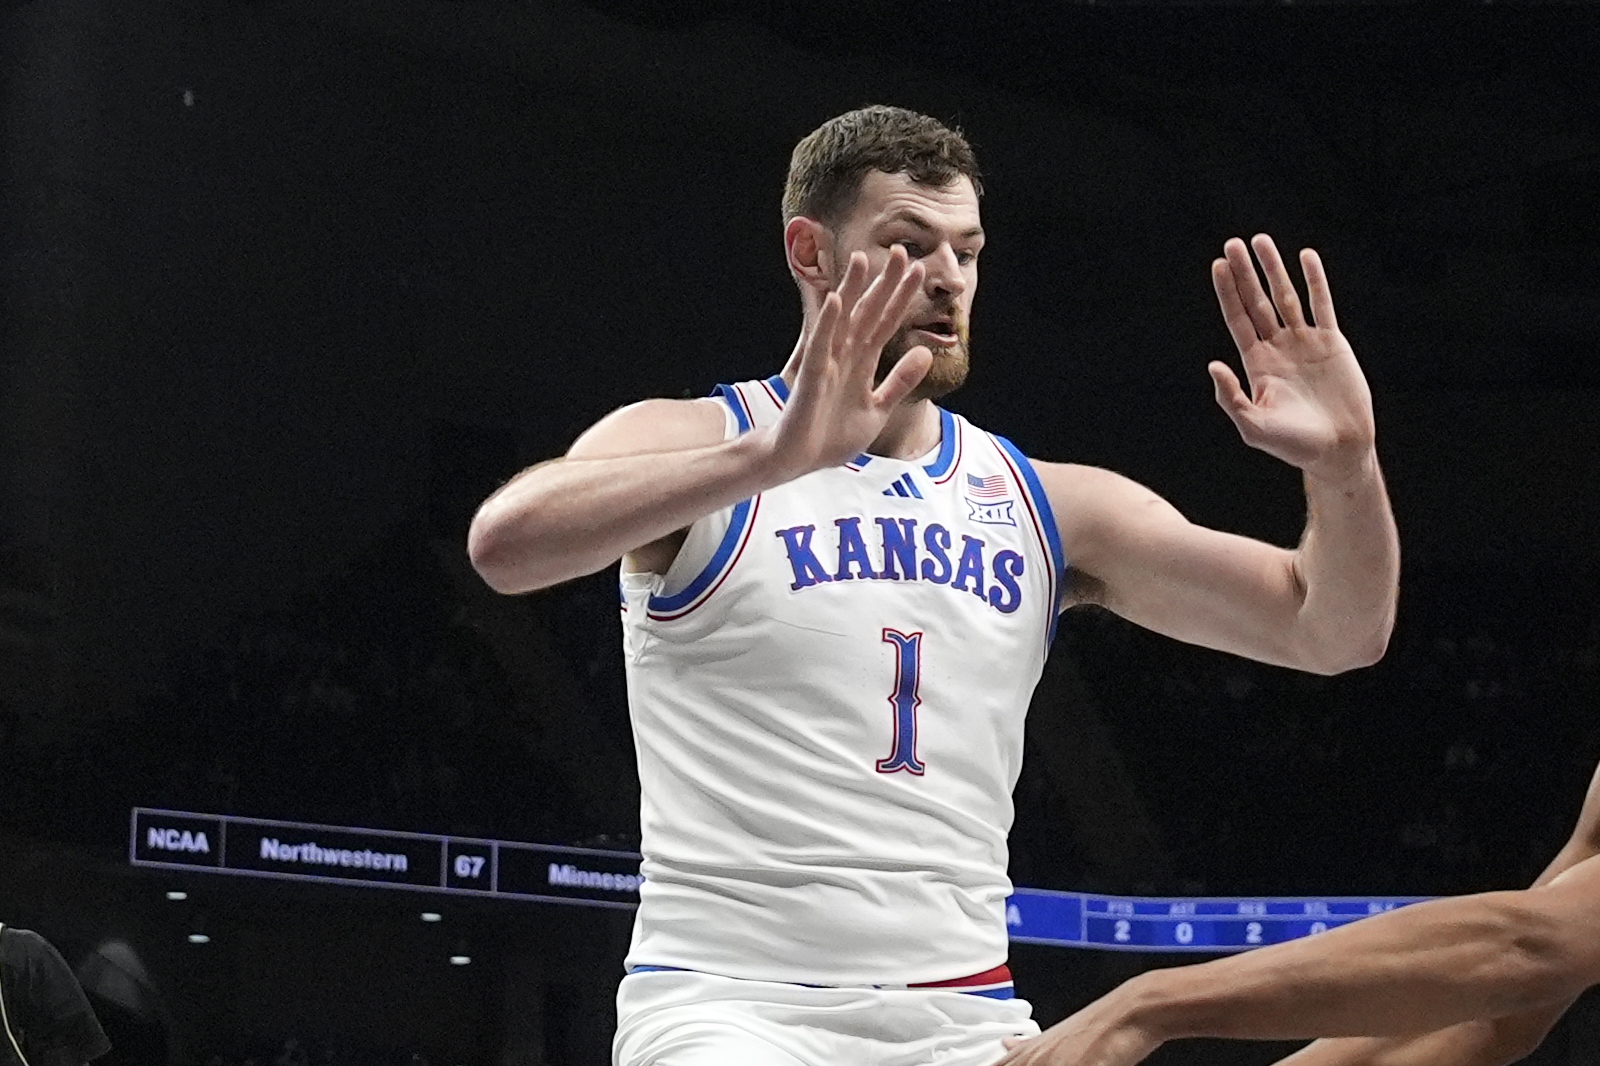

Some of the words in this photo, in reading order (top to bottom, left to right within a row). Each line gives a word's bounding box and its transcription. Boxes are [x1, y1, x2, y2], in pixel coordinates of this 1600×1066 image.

[775, 516, 1025, 615] KANSAS
[876, 628, 925, 776] 1
[147, 826, 210, 854] NCAA
[259, 836, 408, 873] Northwestern
[454, 854, 486, 879] 67
[1114, 919, 1131, 942] 2
[1175, 921, 1194, 944] 0
[1246, 921, 1264, 944] 2
